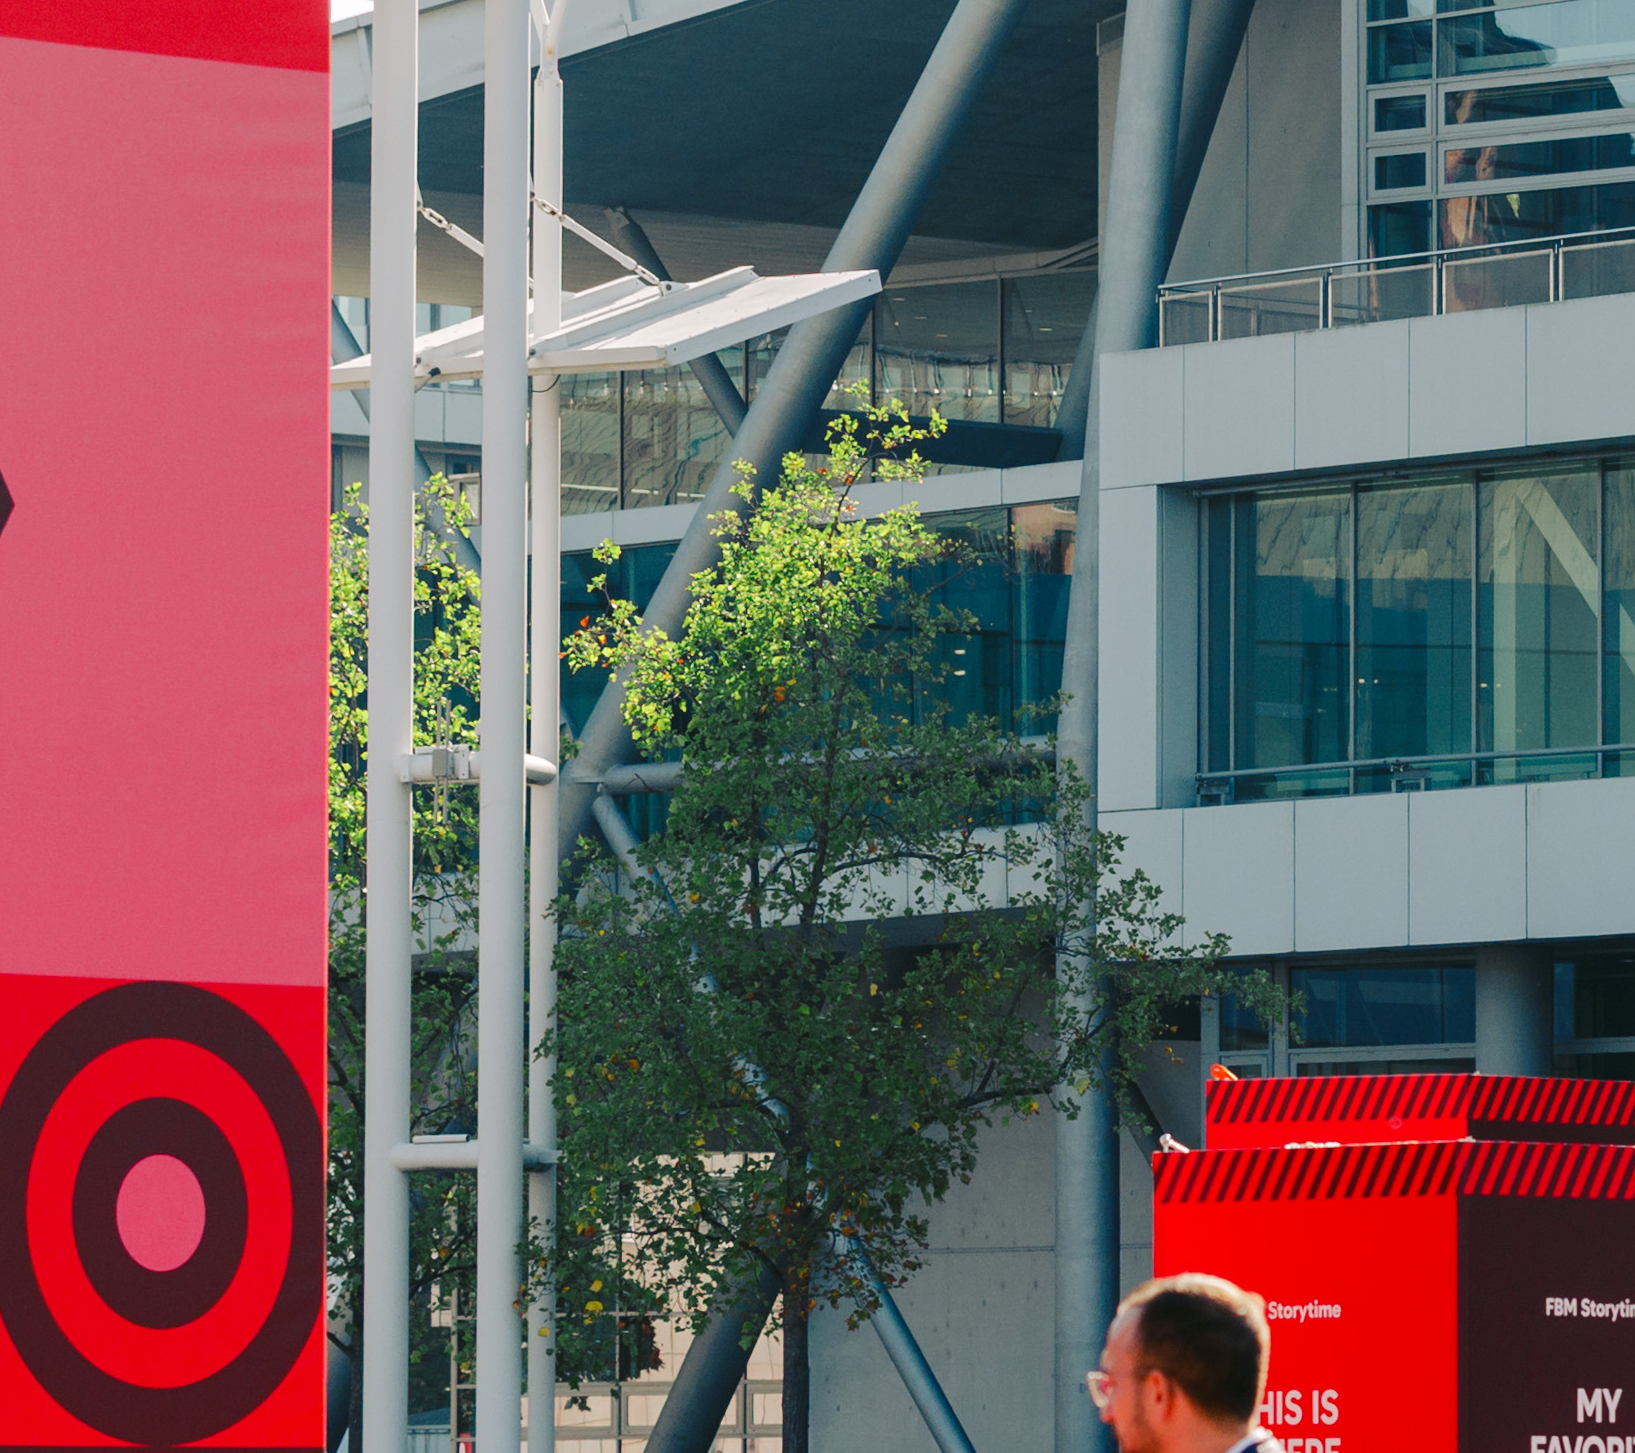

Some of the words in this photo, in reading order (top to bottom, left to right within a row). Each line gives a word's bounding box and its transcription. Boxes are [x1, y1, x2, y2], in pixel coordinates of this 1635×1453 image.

[1268, 1300, 1341, 1322] Storytime
[1545, 1297, 1577, 1317] FBM
[1258, 1389, 1302, 1425] HIS
[1312, 1389, 1339, 1425] IS
[1576, 1388, 1622, 1423] MY
